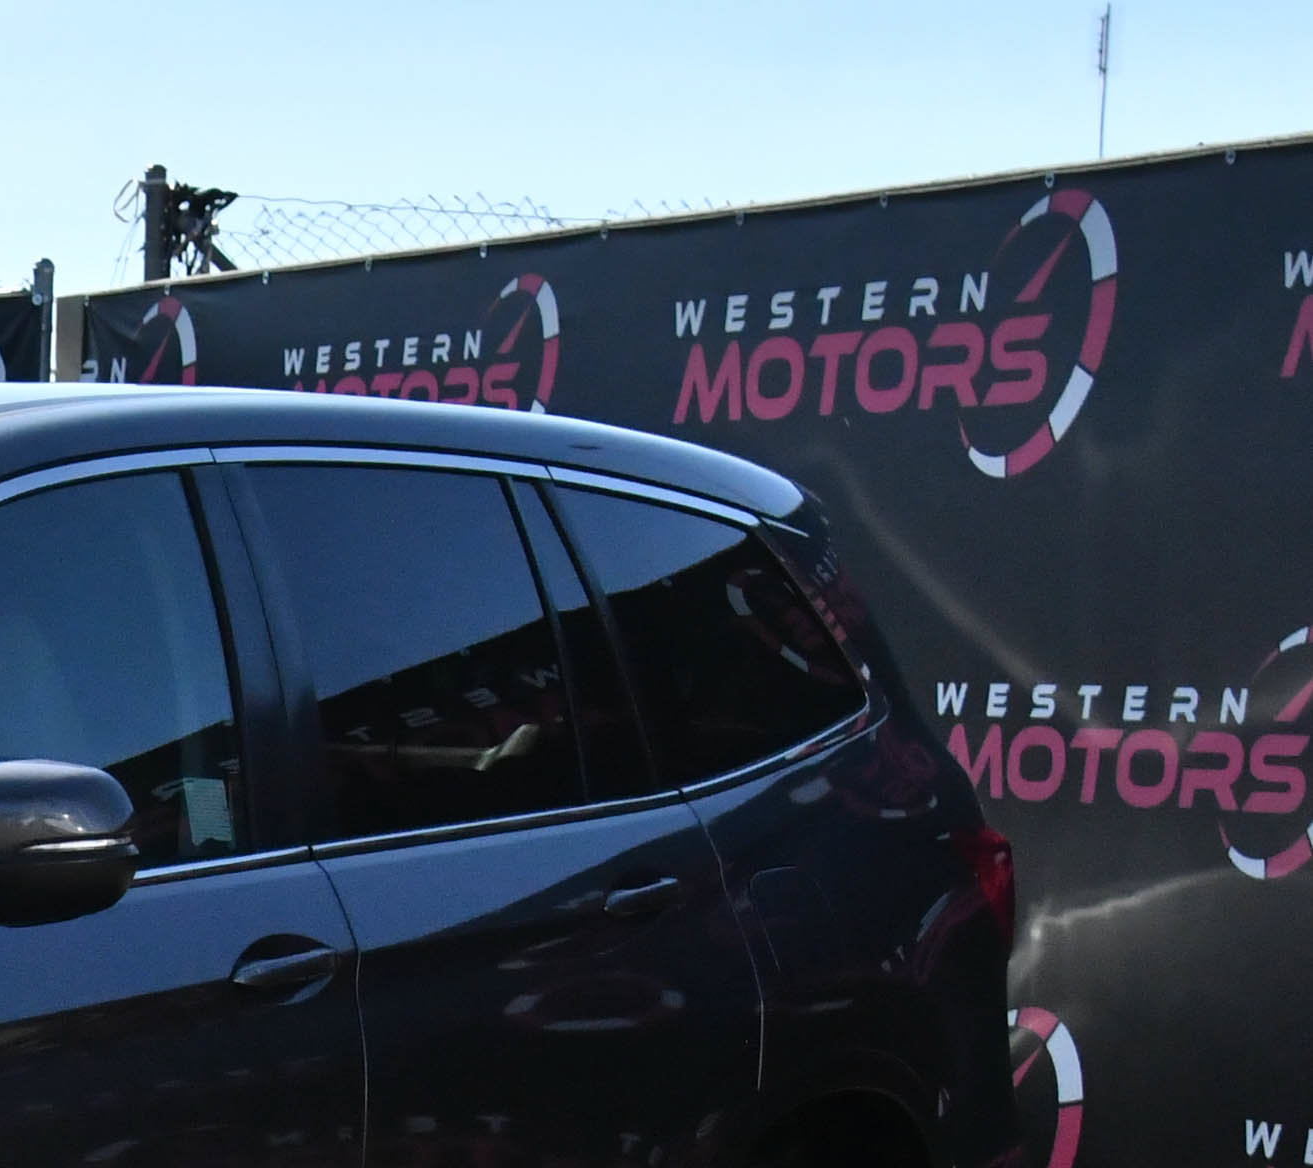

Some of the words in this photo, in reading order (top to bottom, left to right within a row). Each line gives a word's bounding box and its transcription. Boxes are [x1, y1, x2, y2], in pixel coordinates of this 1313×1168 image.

[675, 271, 990, 338] WESTERN
[284, 330, 483, 377] WESTERN
[673, 312, 1053, 424] MOTORS
[936, 682, 1249, 724] WESTERN
[946, 722, 1312, 814] MOTORS
